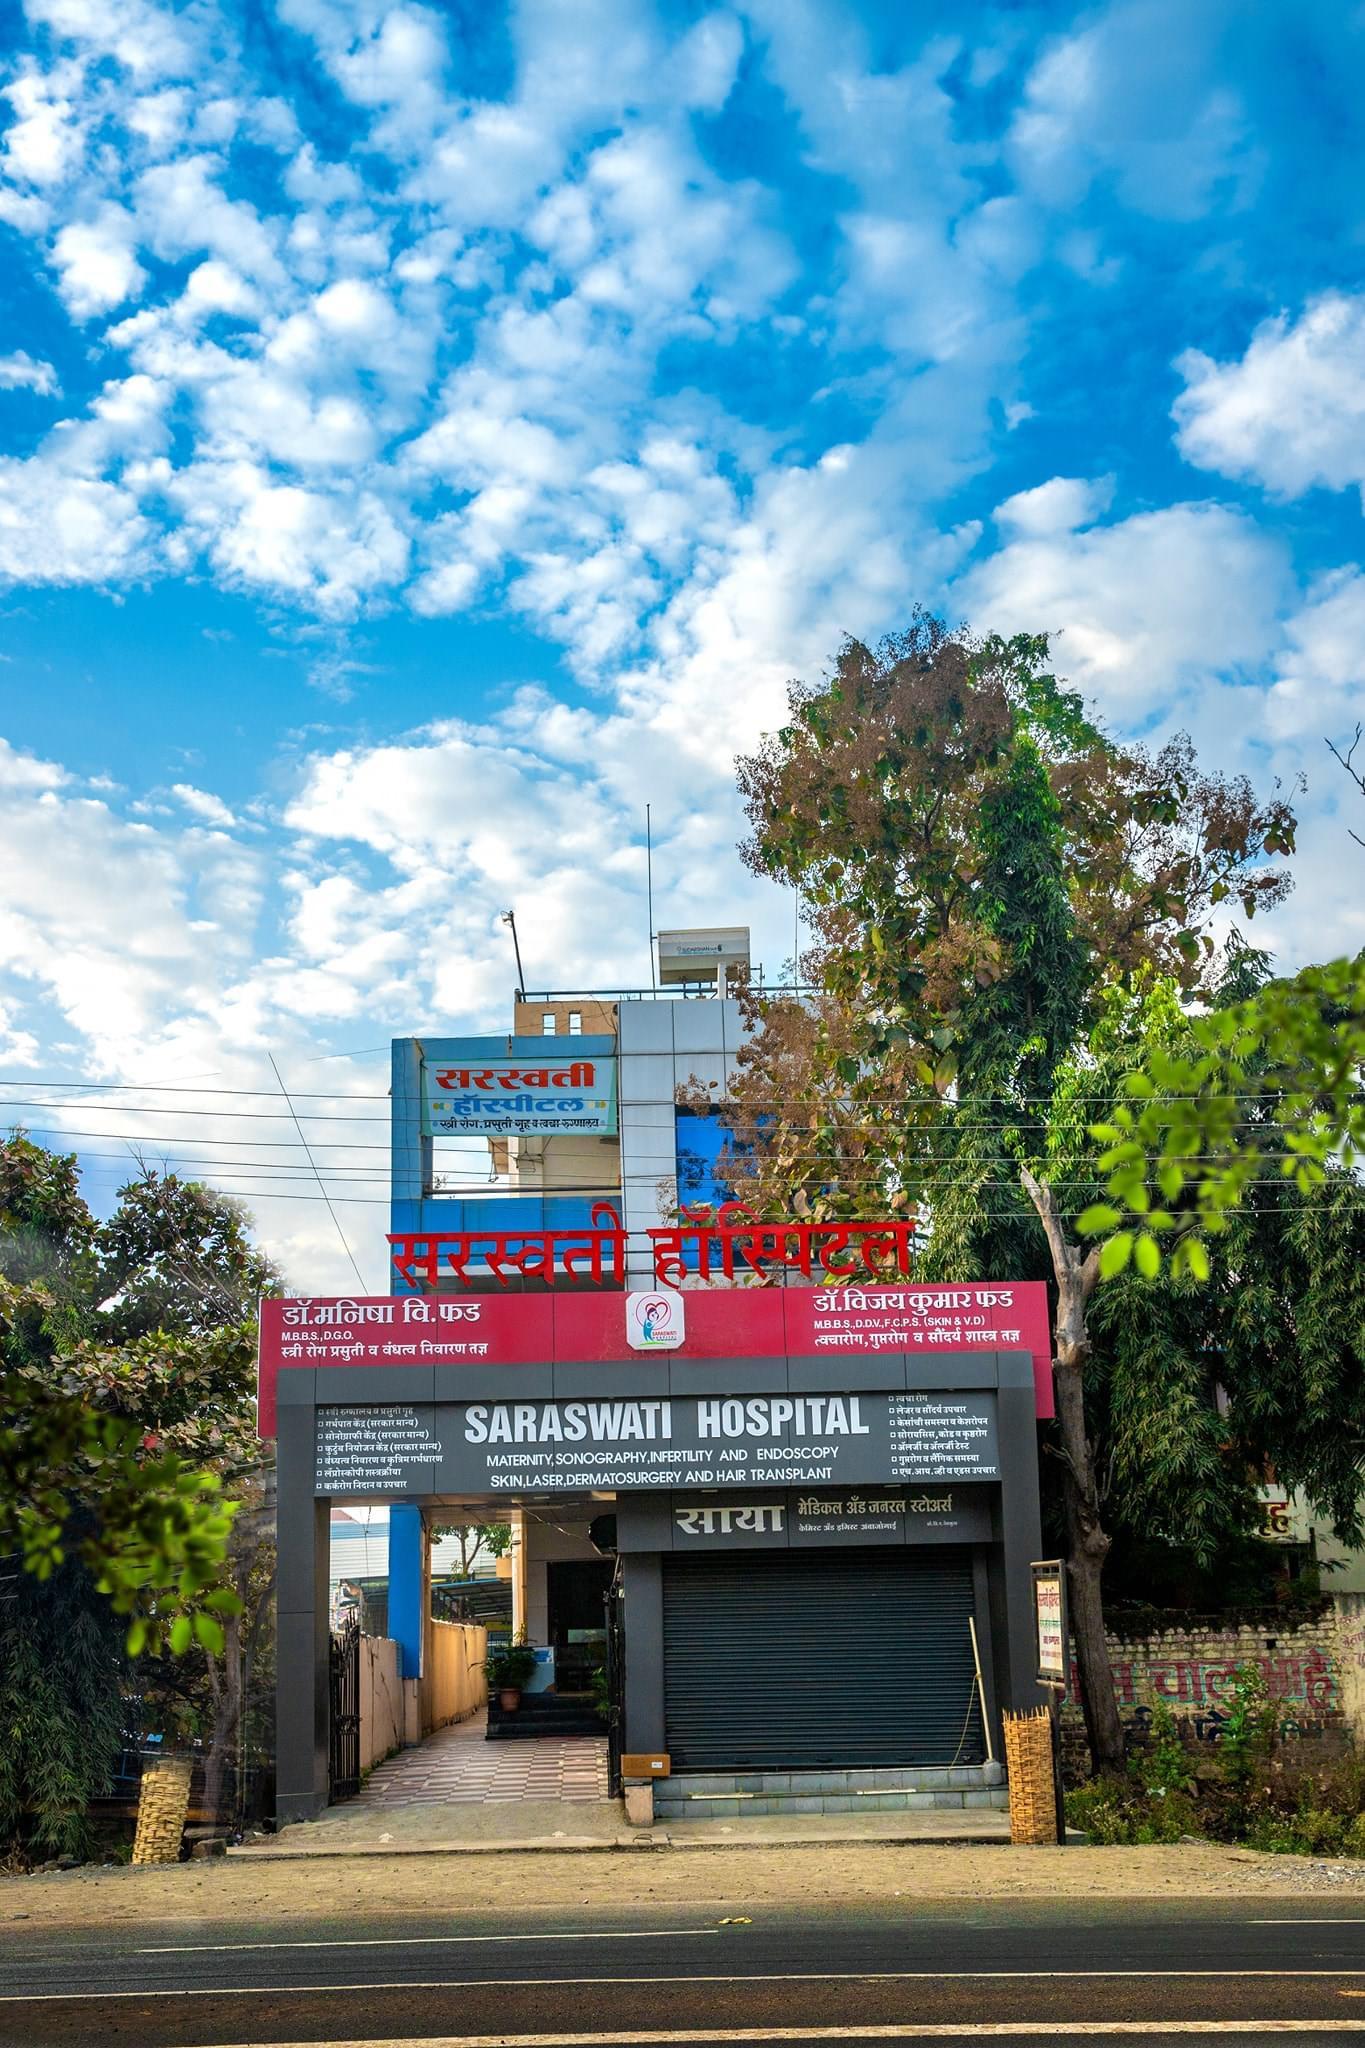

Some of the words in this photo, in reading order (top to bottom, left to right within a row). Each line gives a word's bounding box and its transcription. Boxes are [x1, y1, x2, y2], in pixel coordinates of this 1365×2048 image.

[436, 1062, 596, 1090] सरस्वती
[453, 1094, 583, 1116] हॉस्पीटल
[385, 1202, 629, 1288] सरस्वती
[646, 1202, 916, 1290] हॉस्पिटल
[975, 1290, 1013, 1308] फड
[923, 1316, 952, 1327] (SKIN
[954, 1316, 961, 1326] &
[963, 1314, 985, 1326] V.D)
[913, 1333, 923, 1343] व
[927, 1327, 961, 1343] सौंदर्य
[966, 1330, 997, 1343] शास्त्र
[1001, 1329, 1020, 1342] तज्ञ
[281, 1344, 302, 1359] स्त्री
[306, 1342, 326, 1357] रोग
[330, 1343, 364, 1361] प्रसुती
[368, 1346, 378, 1356] व
[420, 1340, 466, 1355] निवारण
[469, 1343, 488, 1355] तज्ञ
[325, 1418, 352, 1428] गर्भपात
[353, 1417, 366, 1428] केंद्र
[464, 1401, 672, 1444] SARASWATI
[697, 1397, 870, 1439] HOSPITAL
[325, 1430, 362, 1440] सोनोग्राफी
[363, 1429, 377, 1440] केंद्र
[345, 1442, 374, 1452] नियोजन
[375, 1441, 389, 1452] केंद्र
[719, 1450, 748, 1461] AND
[757, 1446, 839, 1461] ENDOSCOPY
[351, 1454, 379, 1464] निवारण
[410, 1453, 443, 1463] गर्भधारण
[685, 1471, 713, 1483] AND
[716, 1469, 746, 1482] HAIR
[750, 1467, 832, 1481] TRANSPLANT
[353, 1479, 375, 1489] निदान
[383, 1480, 407, 1488] उपचार
[798, 1497, 843, 1515] मेडिकल
[868, 1500, 906, 1513] जनरल
[910, 1493, 952, 1512] स्टोअर्स
[675, 1505, 785, 1534] साया
